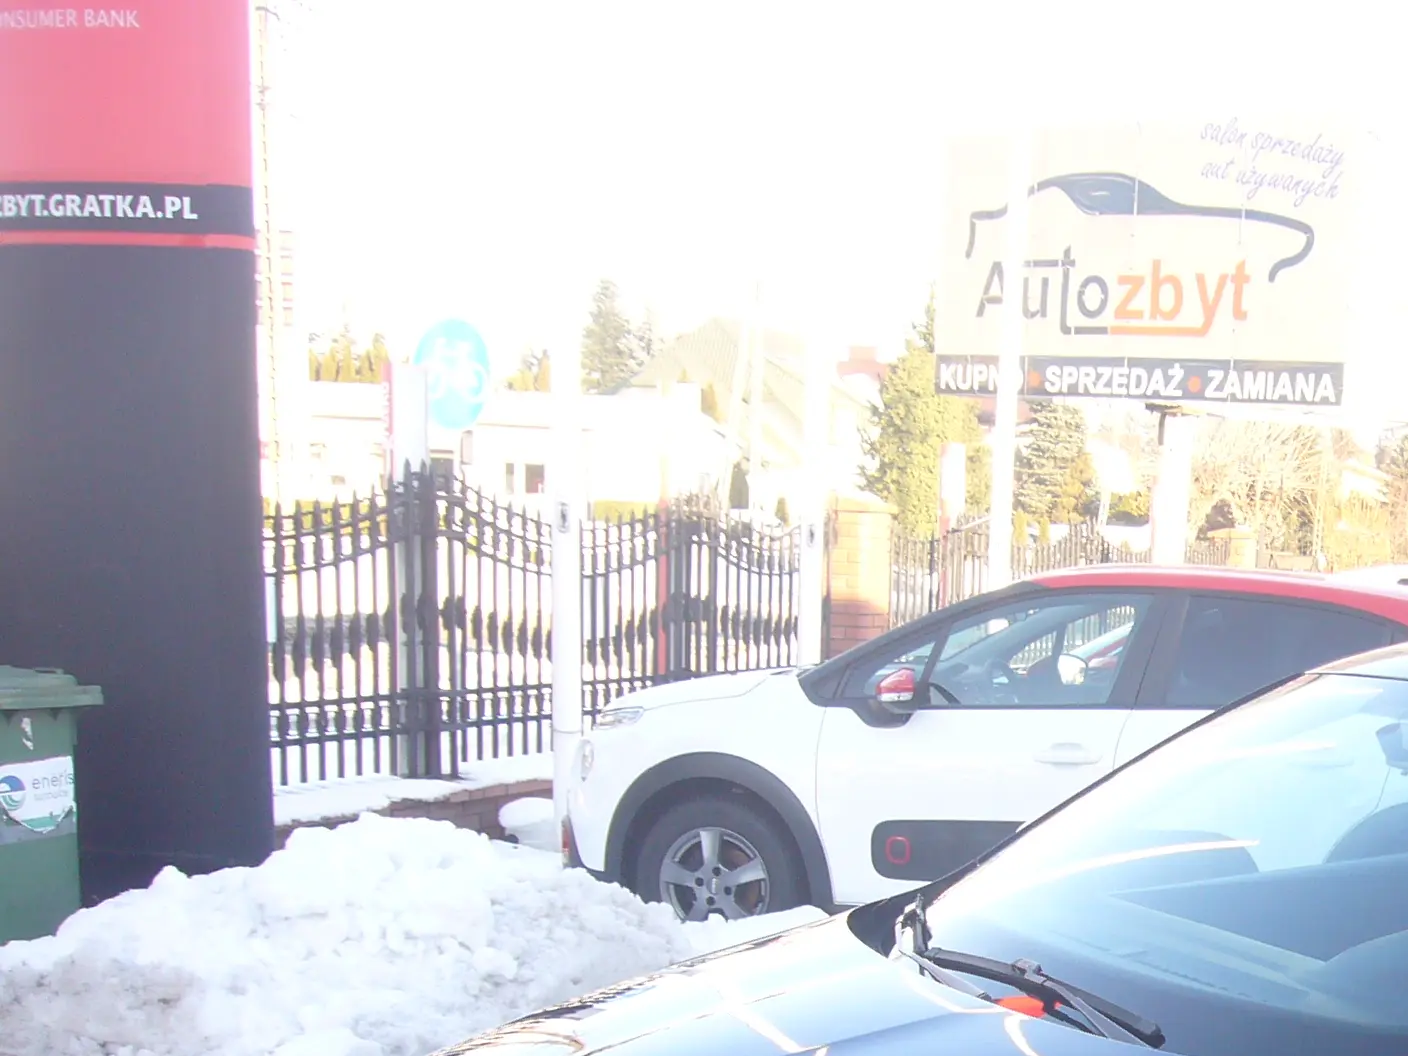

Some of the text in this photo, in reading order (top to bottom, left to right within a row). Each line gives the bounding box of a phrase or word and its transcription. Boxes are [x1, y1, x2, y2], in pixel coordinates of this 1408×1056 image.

[0, 9, 140, 28] NSUMER BANK
[1200, 117, 1345, 179] salon sprzedaży
[1201, 158, 1344, 207] aut używanych
[0, 194, 198, 220] BYT.GRATKA.PL
[1044, 362, 1183, 397] SPRZEDAŻ
[1205, 369, 1336, 402] ZAMIANA
